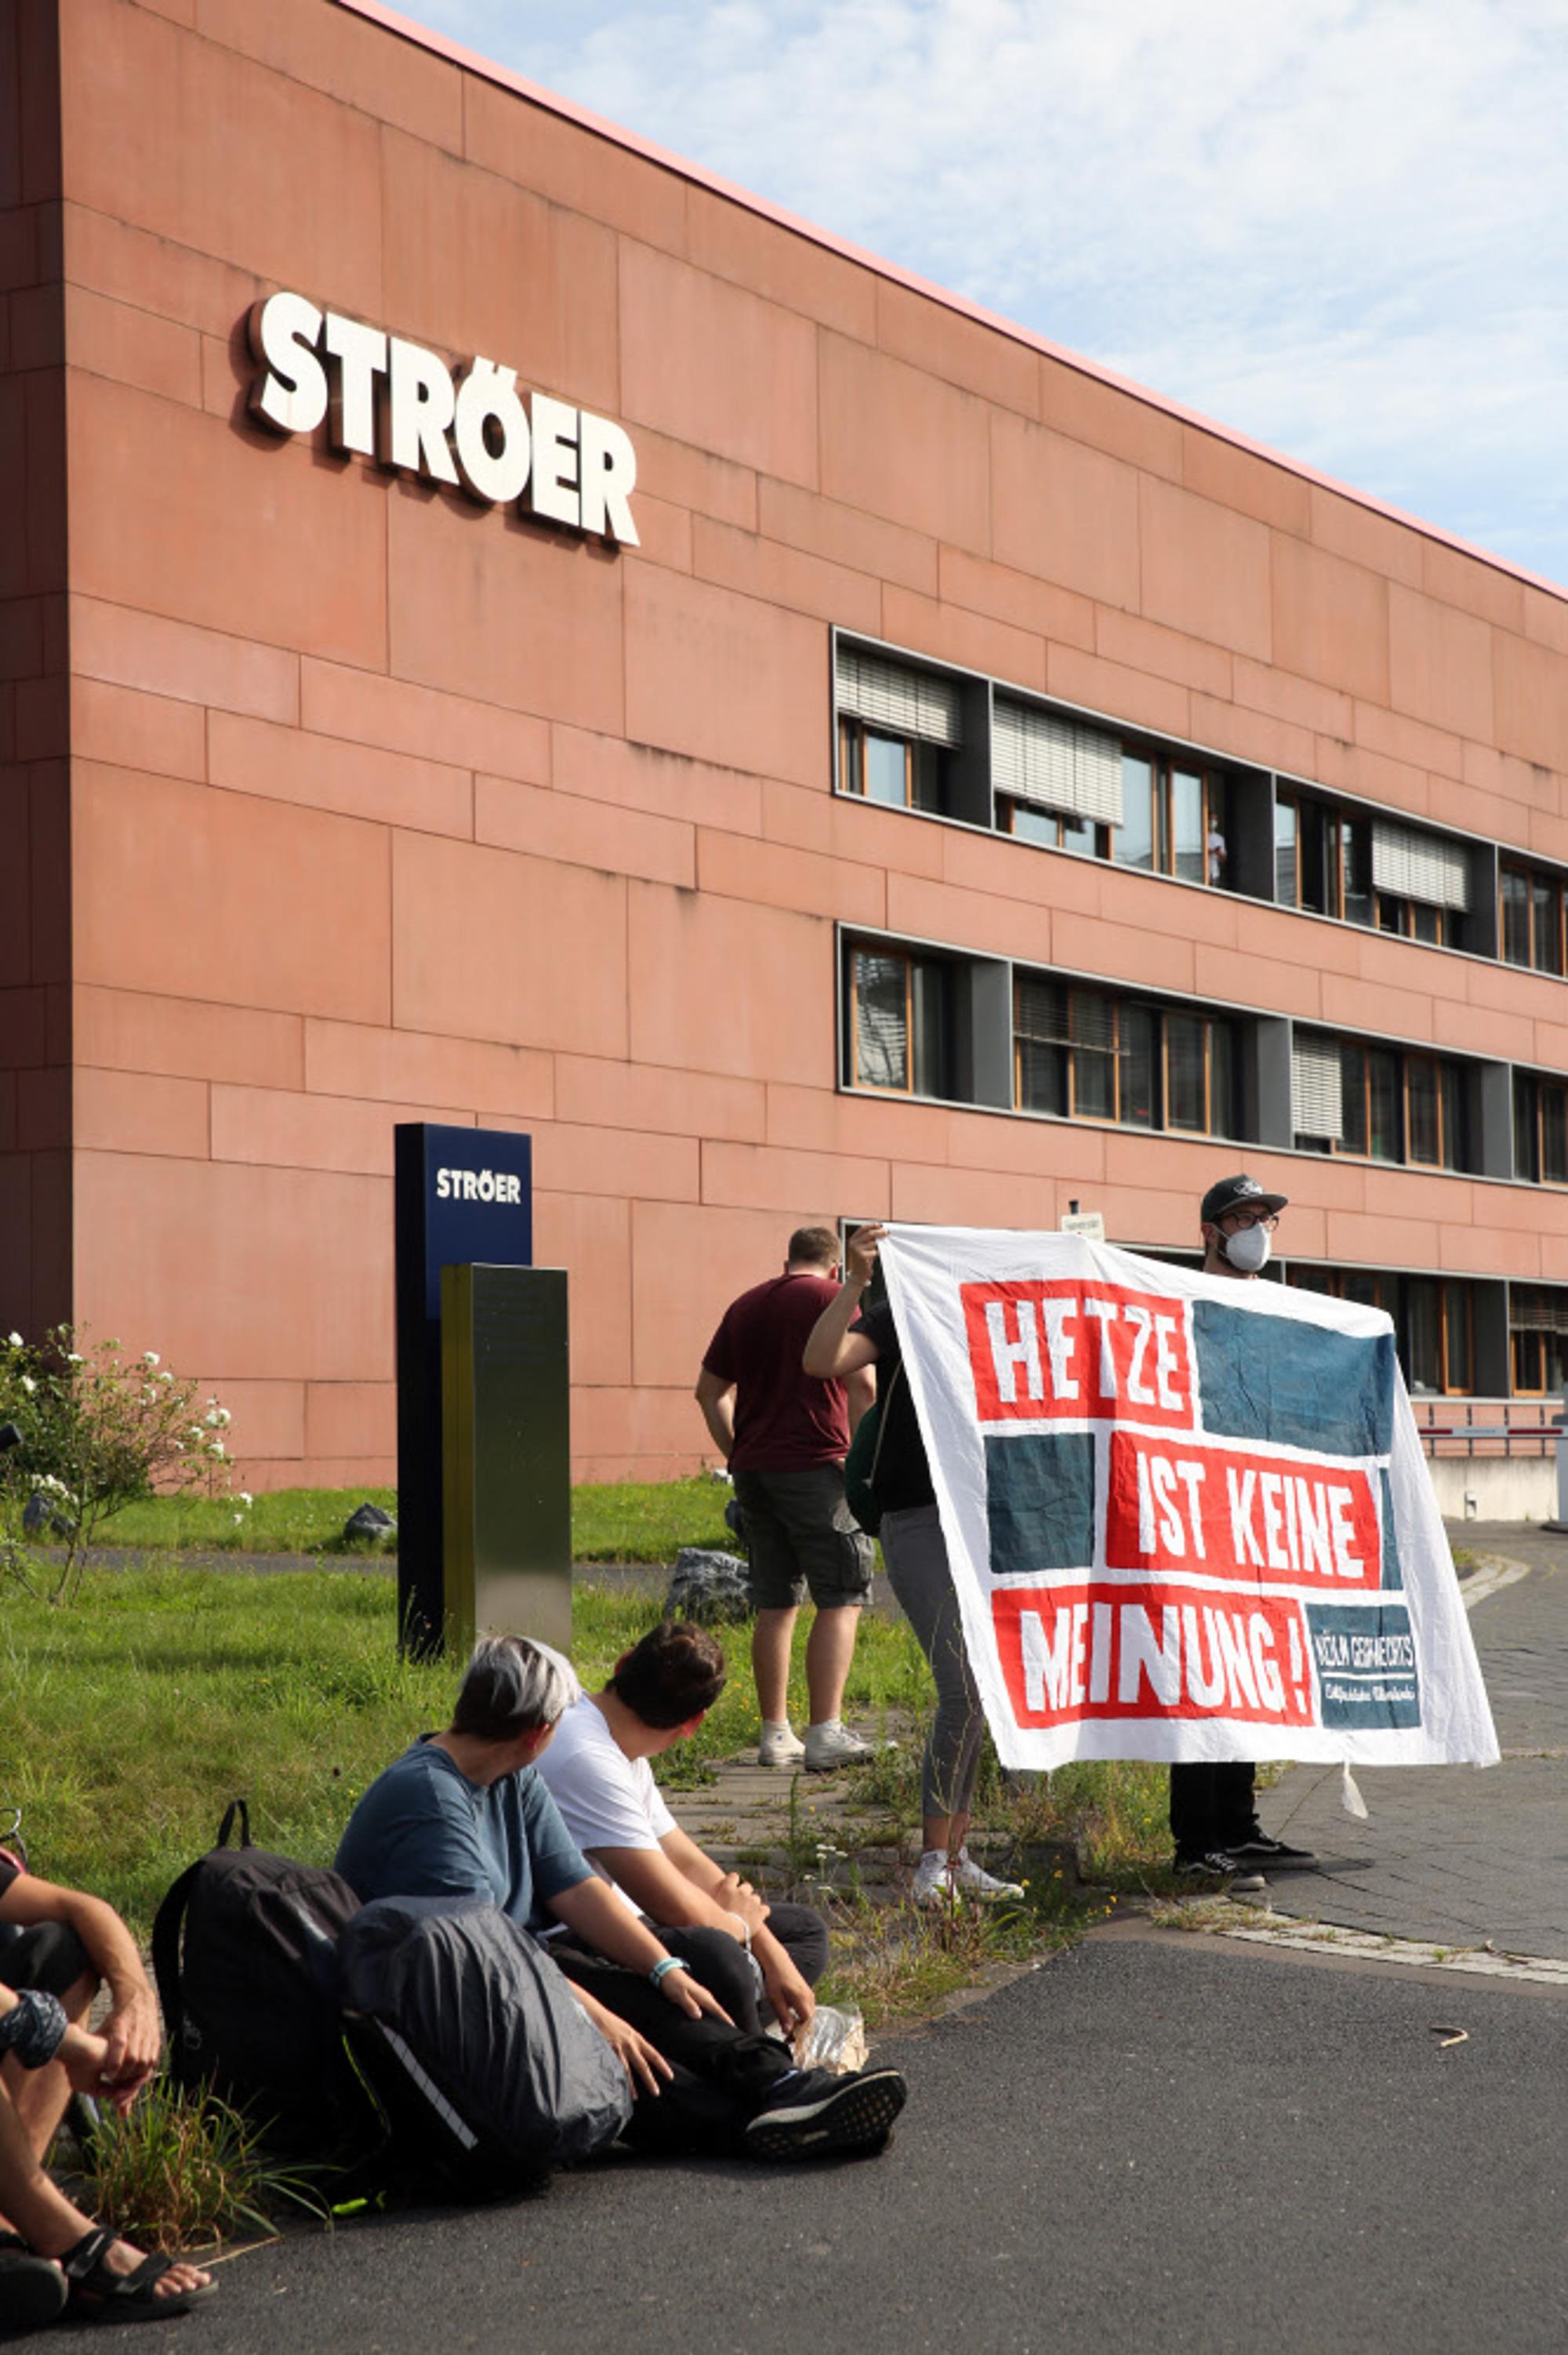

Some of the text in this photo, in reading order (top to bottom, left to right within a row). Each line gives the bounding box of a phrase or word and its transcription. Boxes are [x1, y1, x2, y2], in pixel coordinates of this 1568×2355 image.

[261, 292, 641, 546] STRÖER
[437, 1167, 521, 1204] STRÖER
[985, 1297, 1185, 1413] HETZE
[1137, 1451, 1363, 1579] IST KEINE
